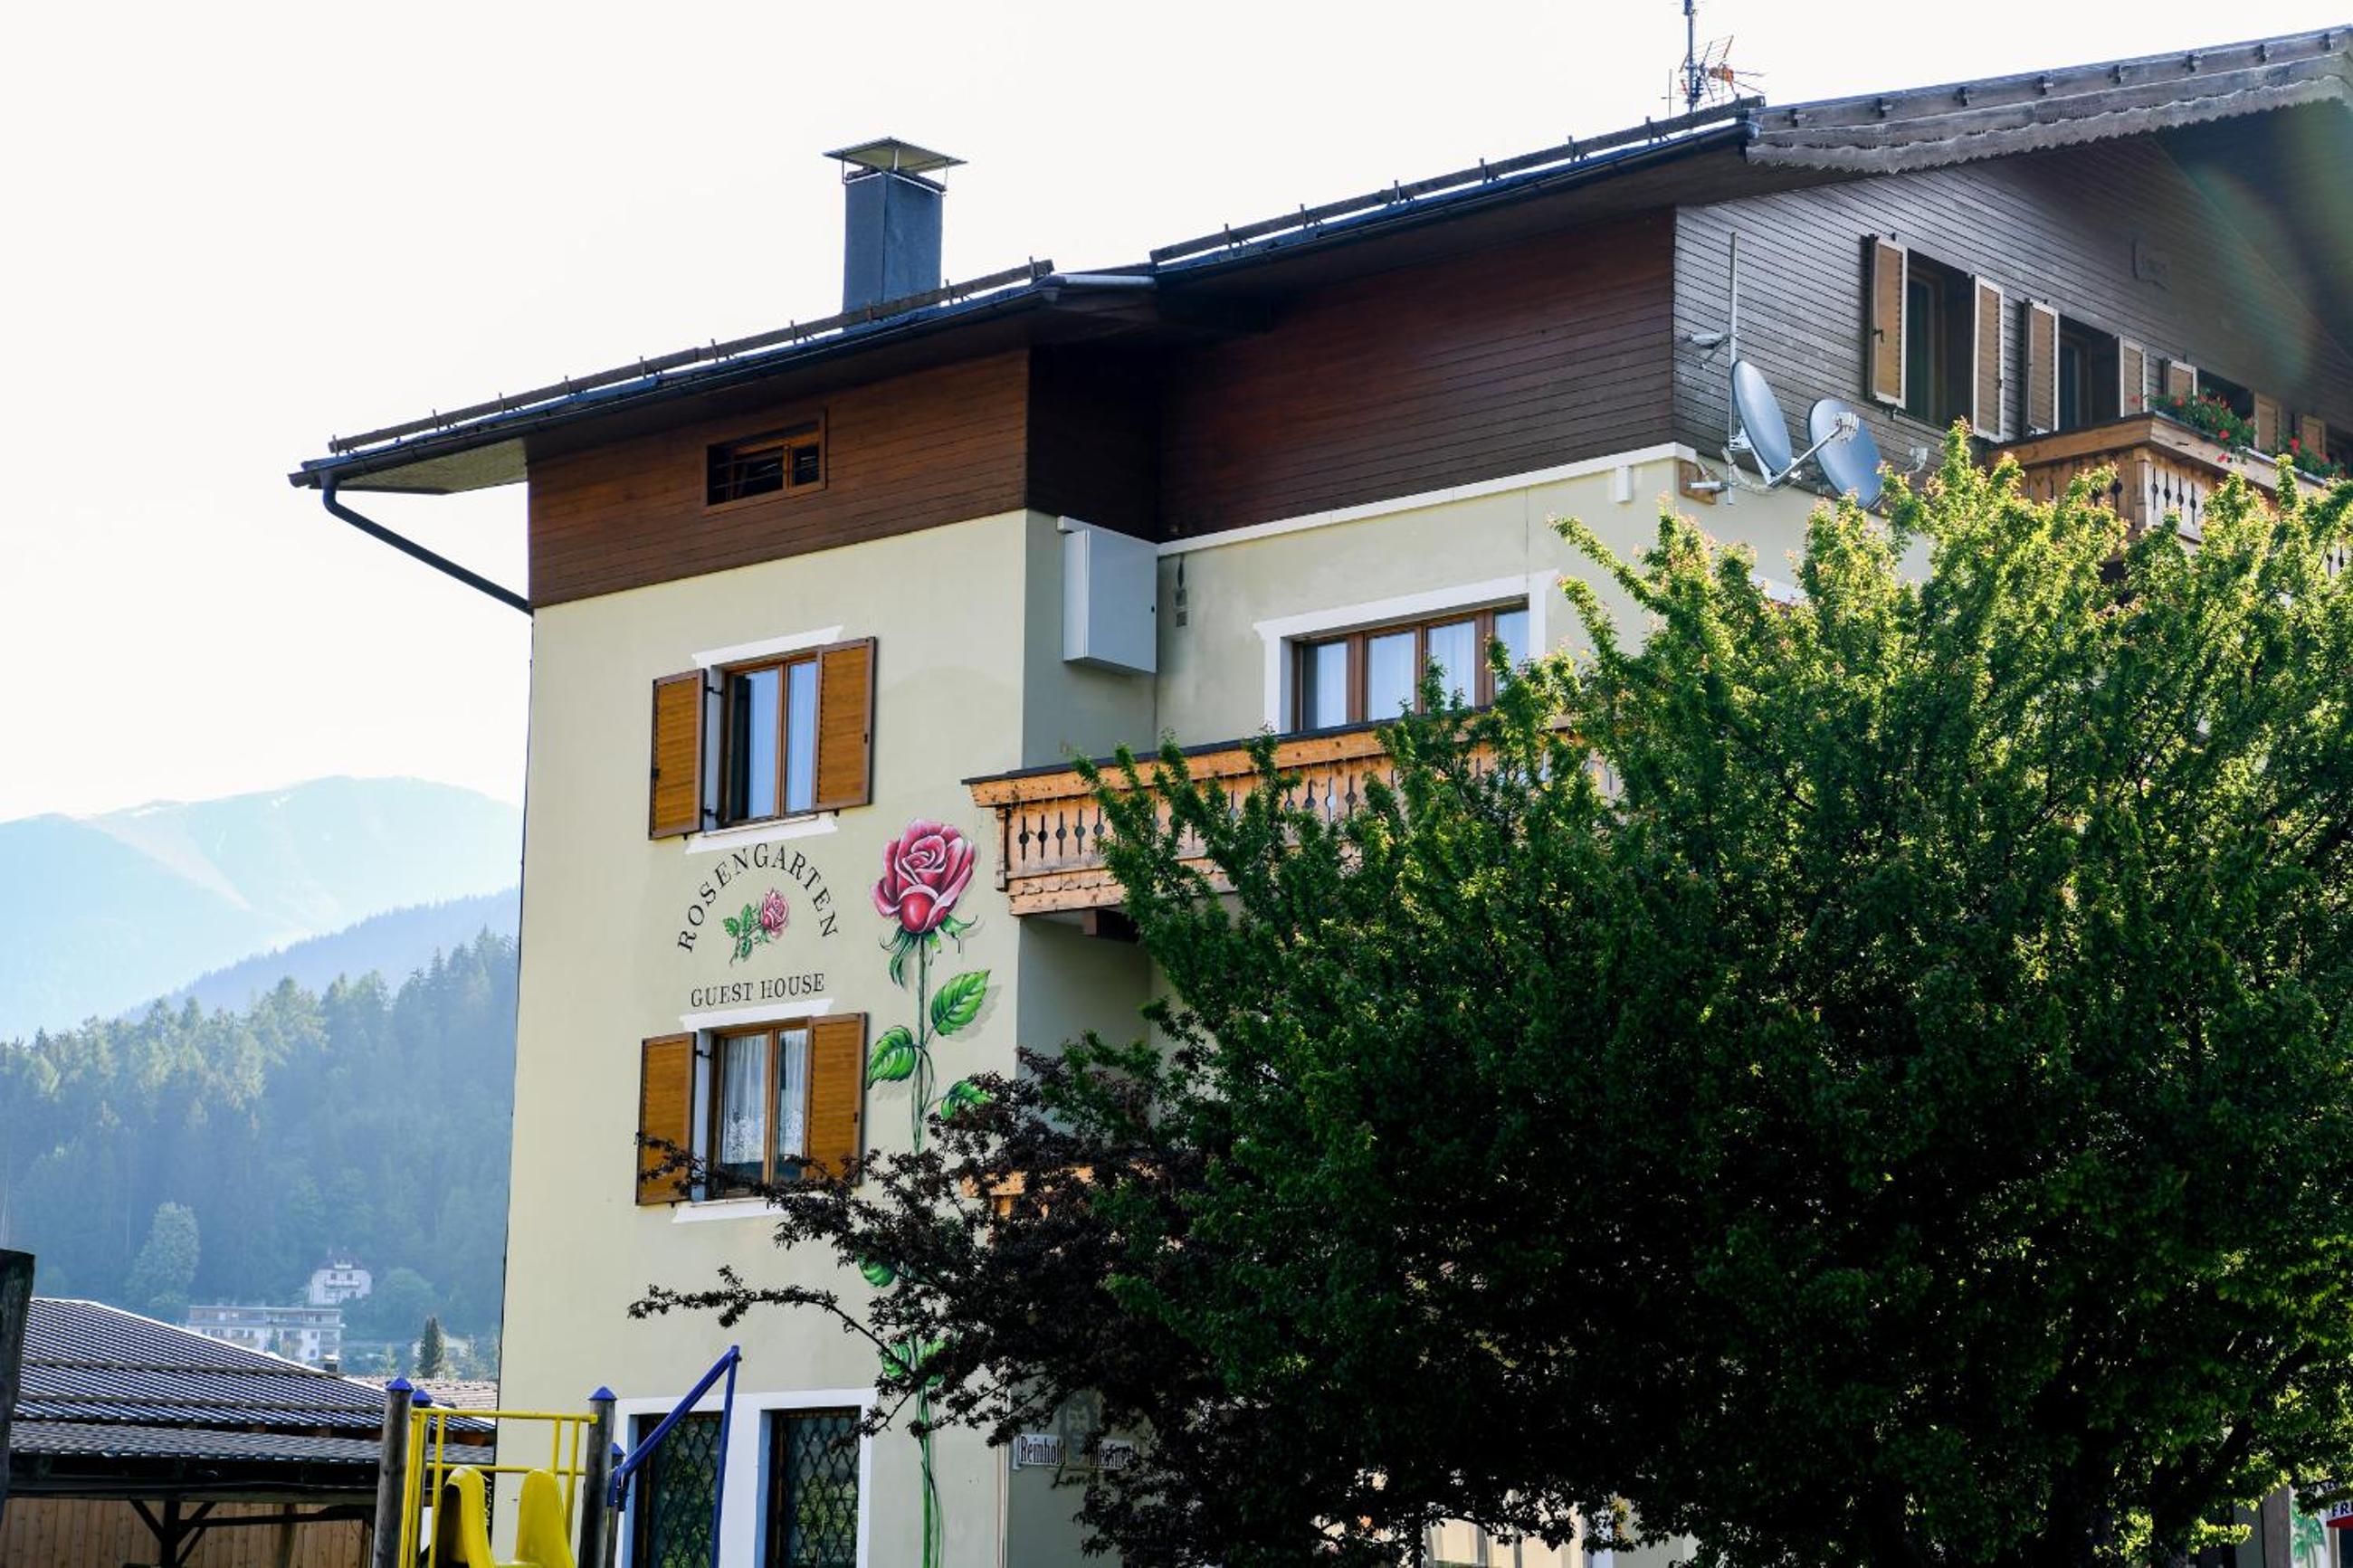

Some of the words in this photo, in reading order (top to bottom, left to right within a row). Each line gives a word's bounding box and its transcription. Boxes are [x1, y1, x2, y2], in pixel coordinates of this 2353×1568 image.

[677, 842, 838, 952] ROSENGARTEN
[691, 982, 753, 1007] GUEST
[760, 973, 824, 999] HOUSE
